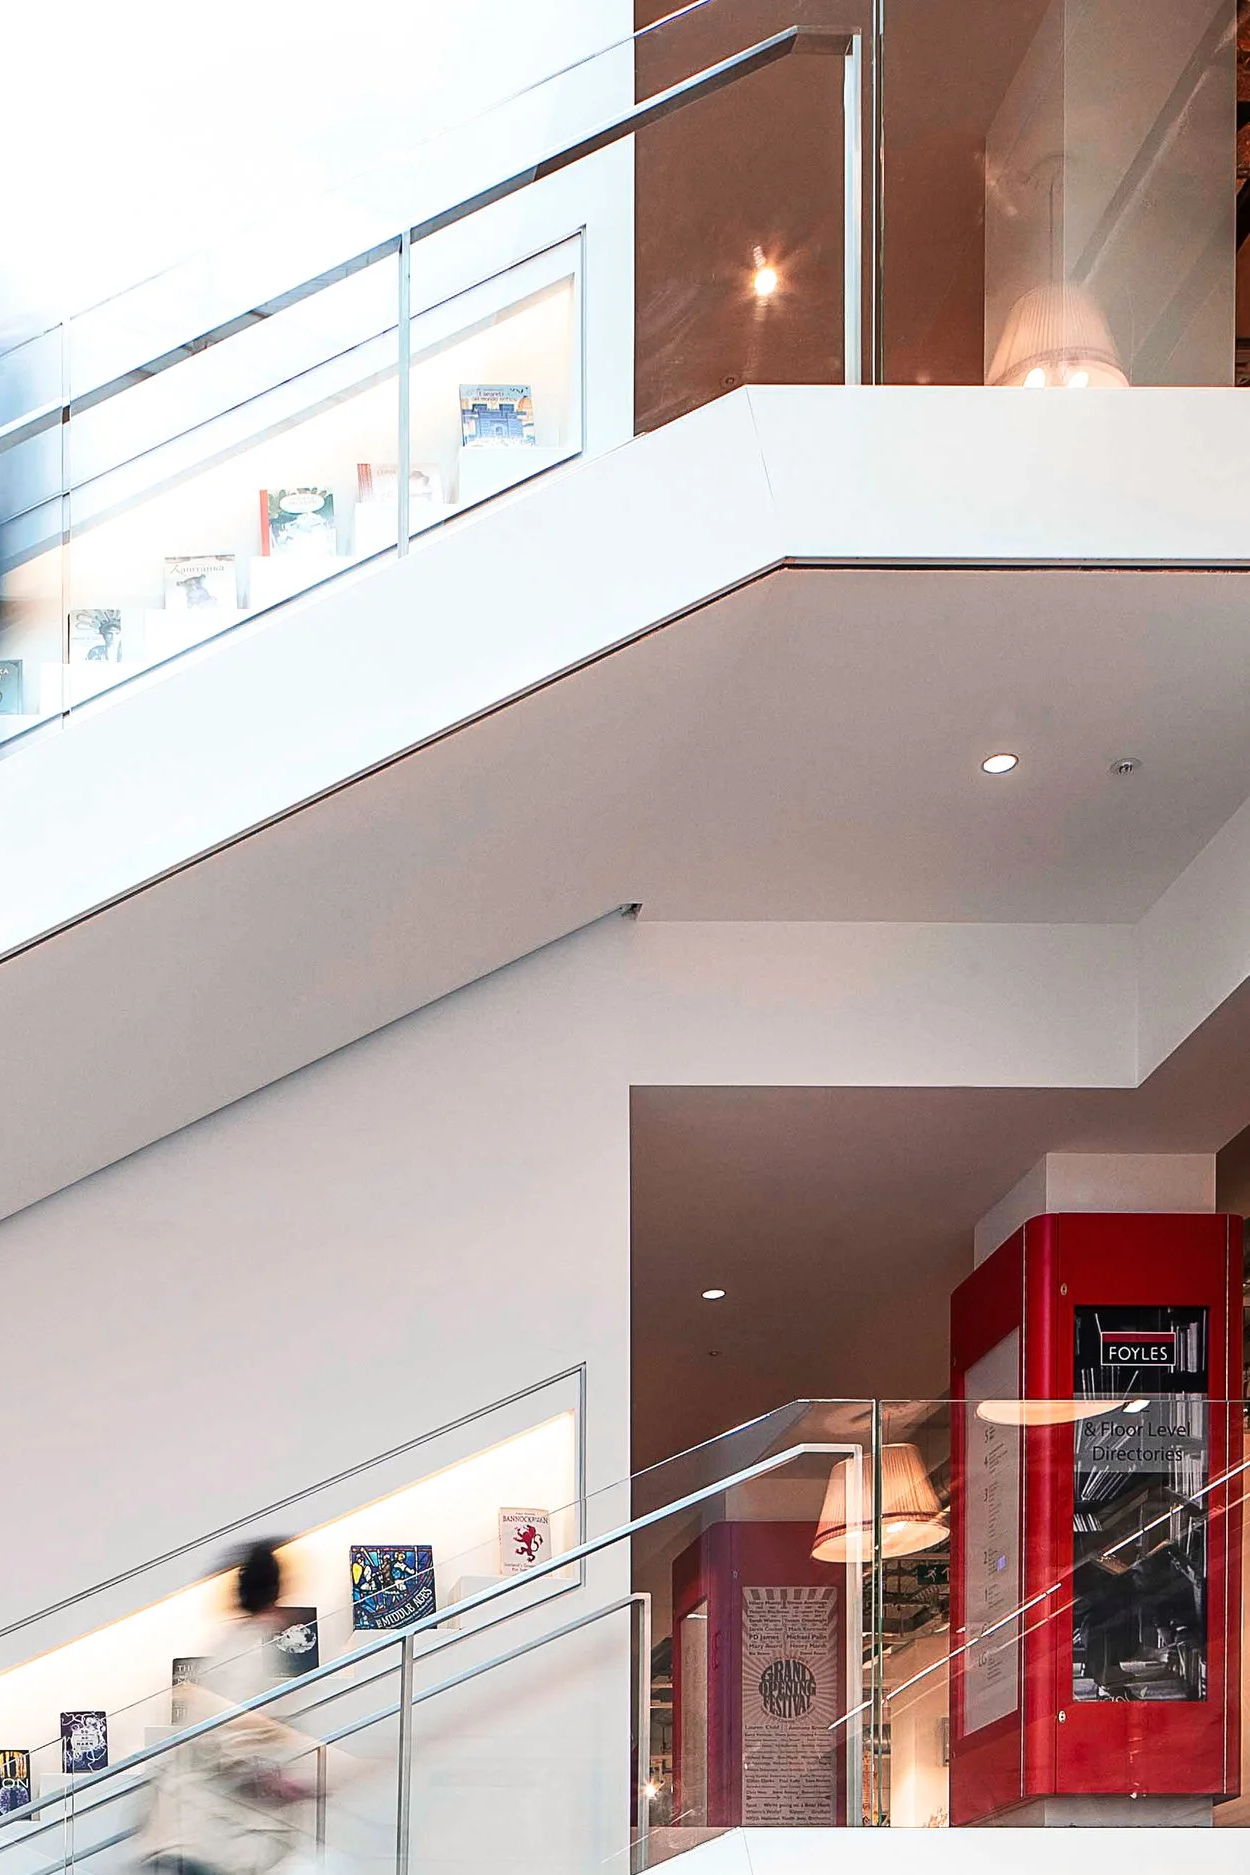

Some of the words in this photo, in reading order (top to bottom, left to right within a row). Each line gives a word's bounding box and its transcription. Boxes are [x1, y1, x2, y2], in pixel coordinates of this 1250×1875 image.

[1108, 1346, 1169, 1361] FOYLES
[1084, 1421, 1098, 1438] &
[1101, 1420, 1145, 1438] Floor
[1148, 1420, 1191, 1438] Level
[1092, 1446, 1184, 1463] Directories
[381, 1603, 414, 1627] MIDDLE
[413, 1586, 433, 1608] AGES
[761, 1660, 816, 1682] GRAND
[758, 1680, 816, 1696] OPENING
[763, 1694, 811, 1719] FESTIVAL
